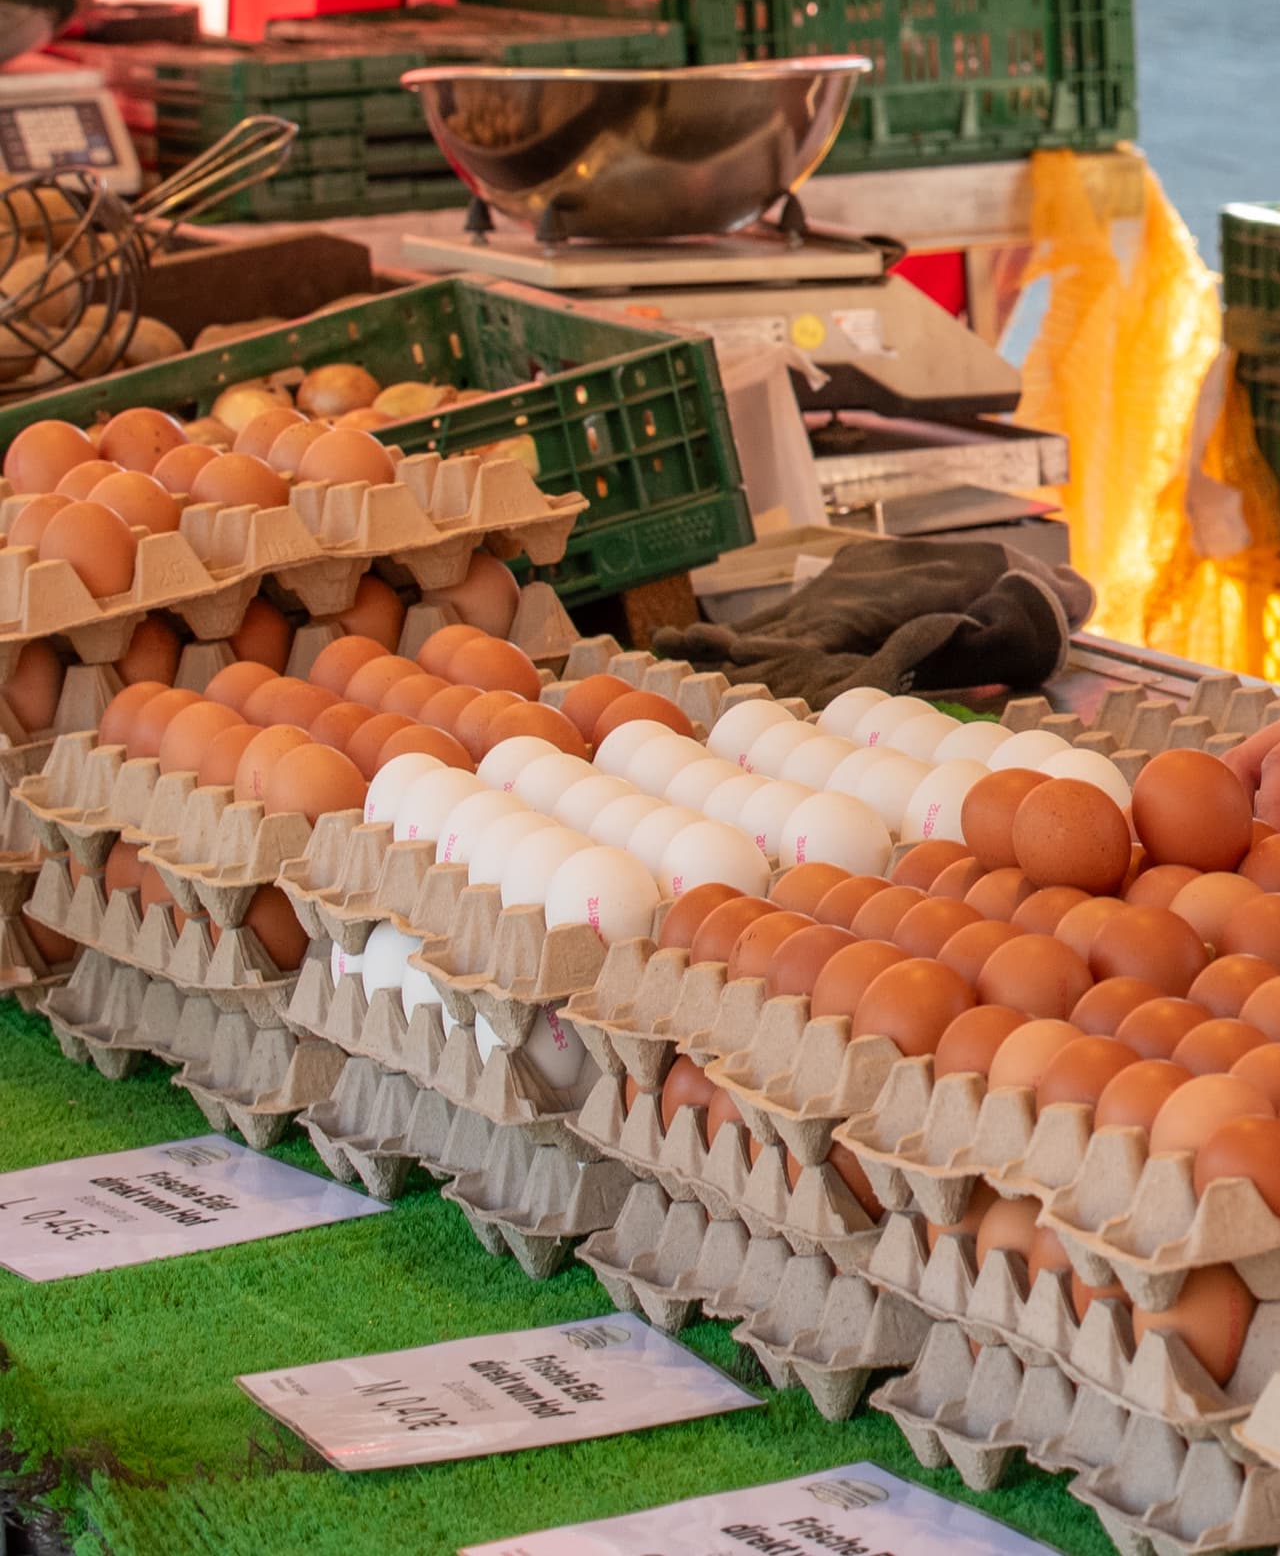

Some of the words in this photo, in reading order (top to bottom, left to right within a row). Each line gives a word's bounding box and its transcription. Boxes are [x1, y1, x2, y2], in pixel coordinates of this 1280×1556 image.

[89, 1176, 152, 1199] direkt
[133, 1195, 180, 1214] vom
[164, 1208, 219, 1227] Hof
[136, 1171, 206, 1198] Frische
[191, 1194, 239, 1212] Eier
[21, 1210, 110, 1241] 0,45€
[353, 1379, 410, 1397] M
[468, 1360, 527, 1386] direkt
[501, 1381, 544, 1403] vom
[523, 1398, 577, 1419] Hof
[519, 1354, 581, 1386] Frische
[561, 1382, 605, 1403] Eier
[371, 1396, 458, 1431] 0,40€
[720, 1524, 803, 1556] direkt
[777, 1516, 870, 1556] Frische
